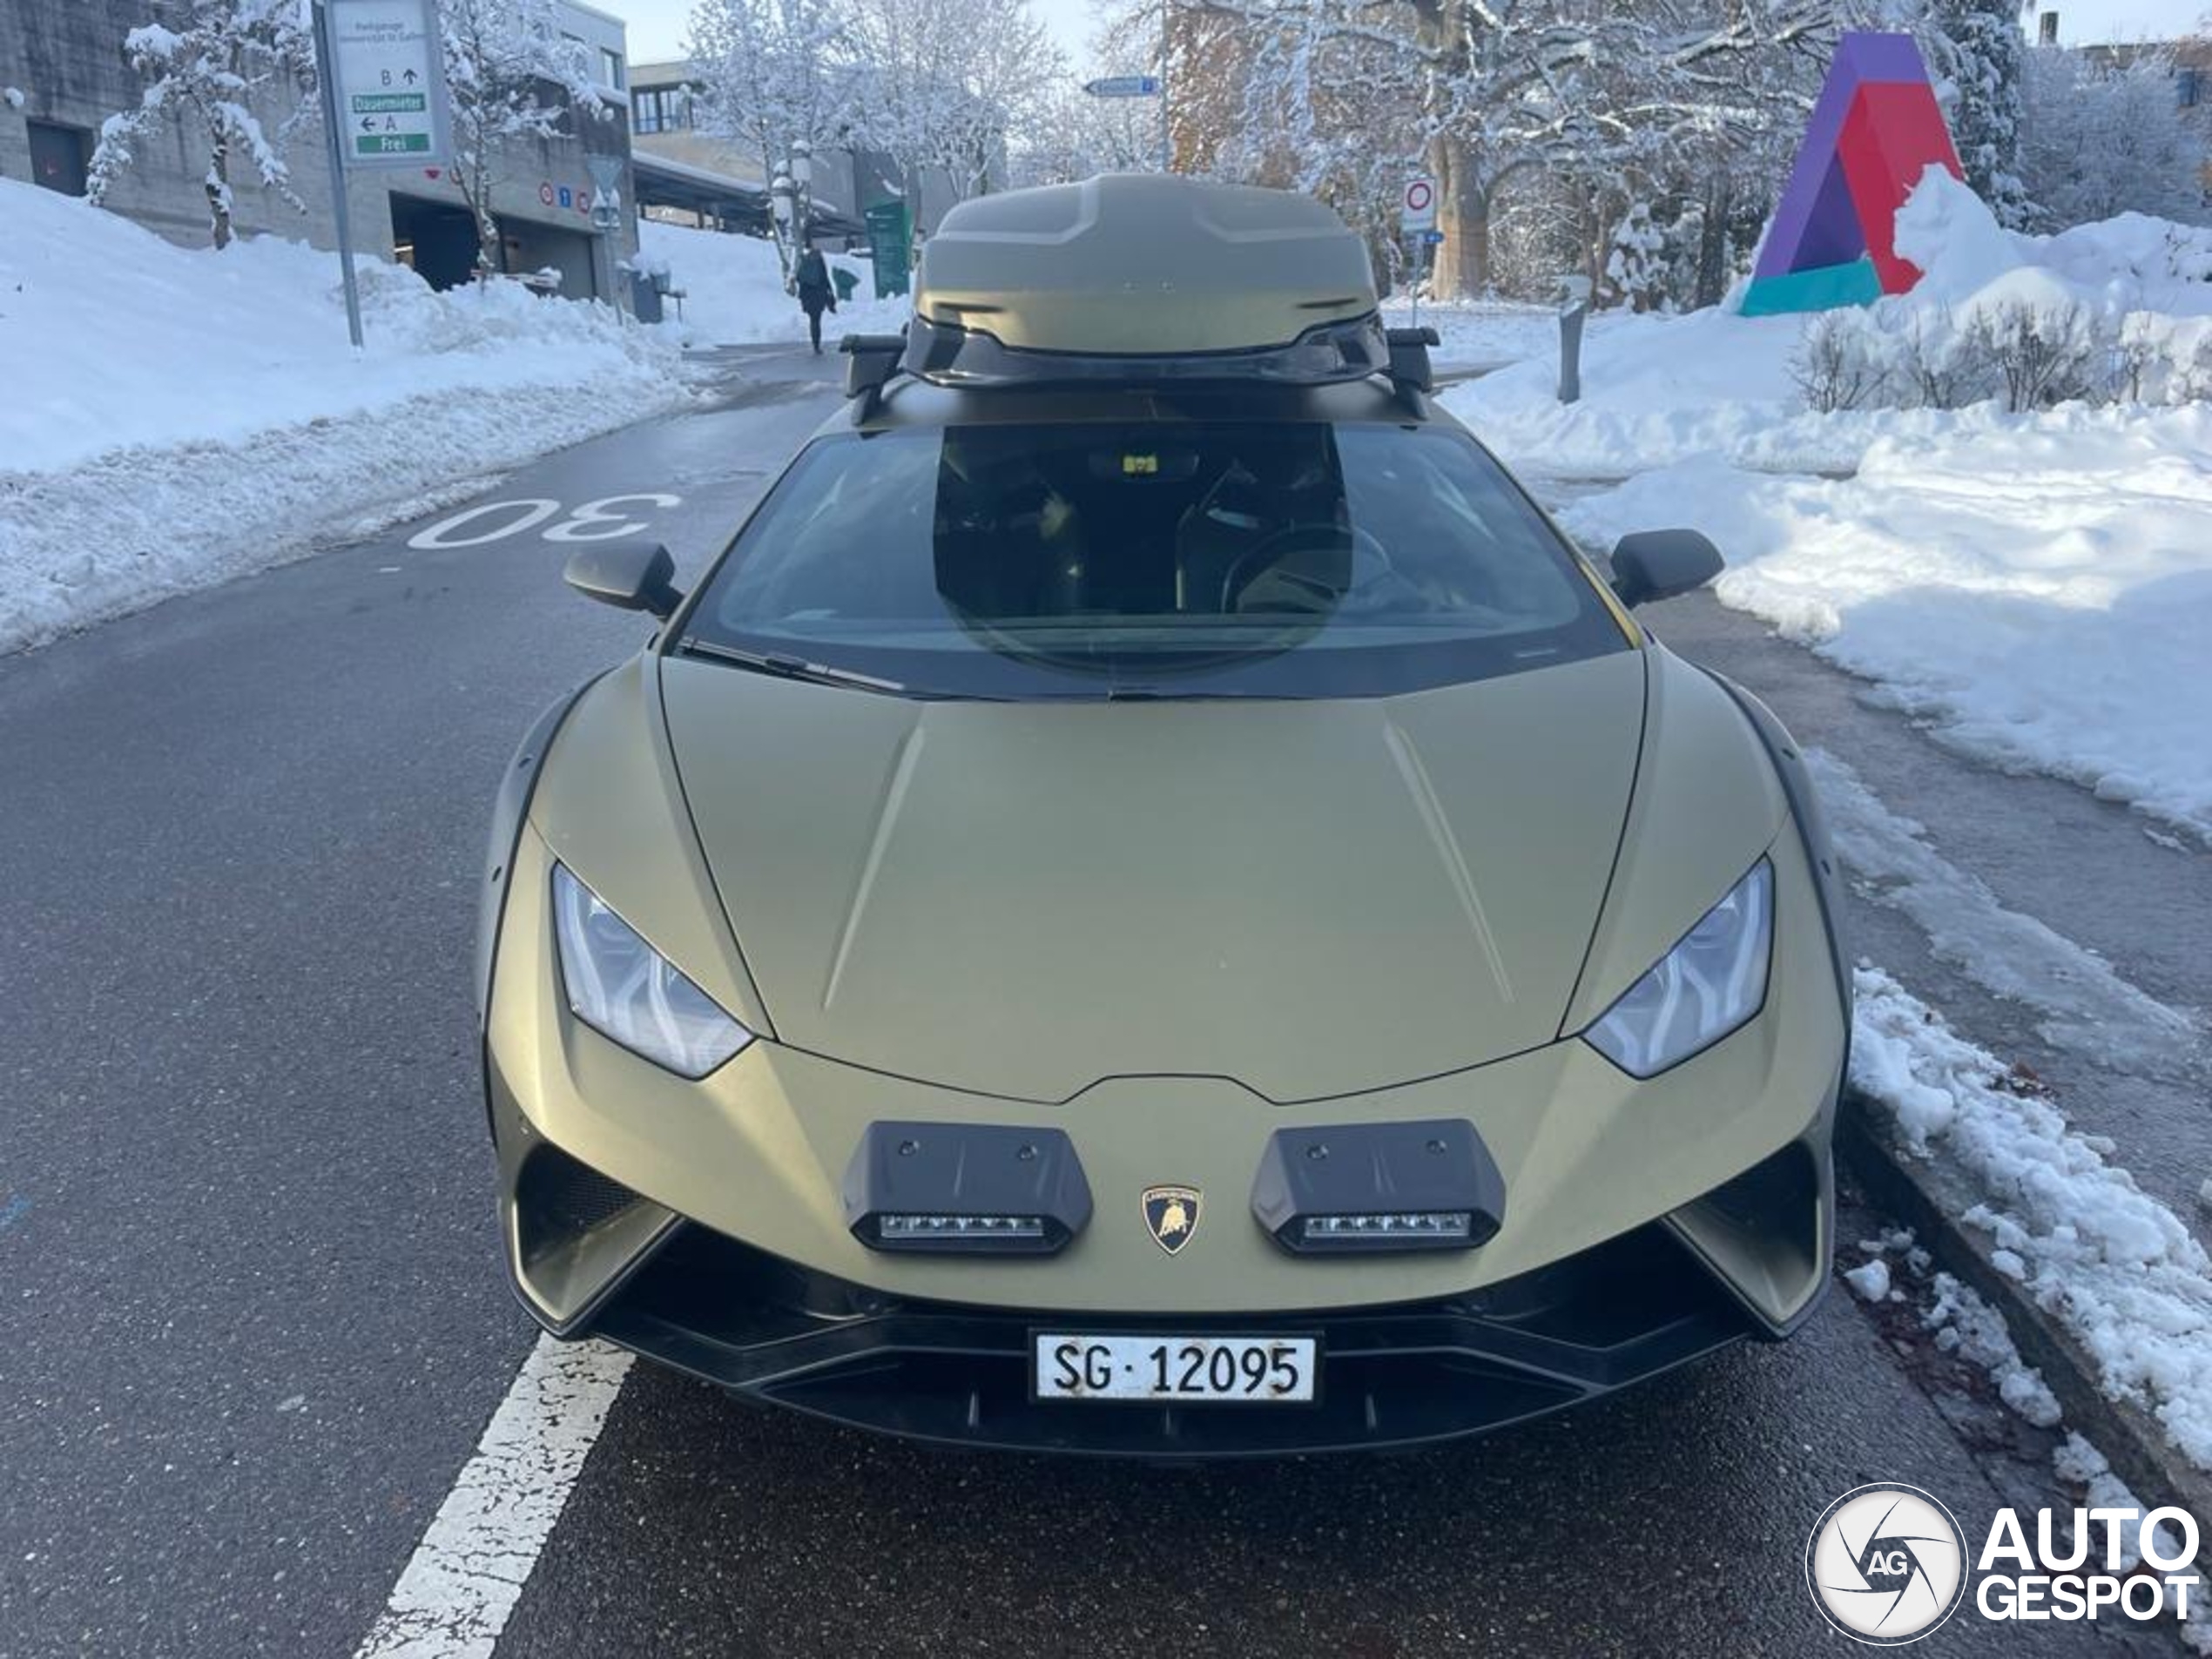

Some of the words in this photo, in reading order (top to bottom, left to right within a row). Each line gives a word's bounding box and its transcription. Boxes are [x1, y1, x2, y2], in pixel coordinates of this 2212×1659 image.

[381, 70, 392, 85] B
[386, 114, 397, 131] A
[381, 136, 407, 152] Frei
[407, 494, 682, 550] 30
[1054, 1344, 1111, 1391] SG
[1150, 1345, 1298, 1394] 12095
